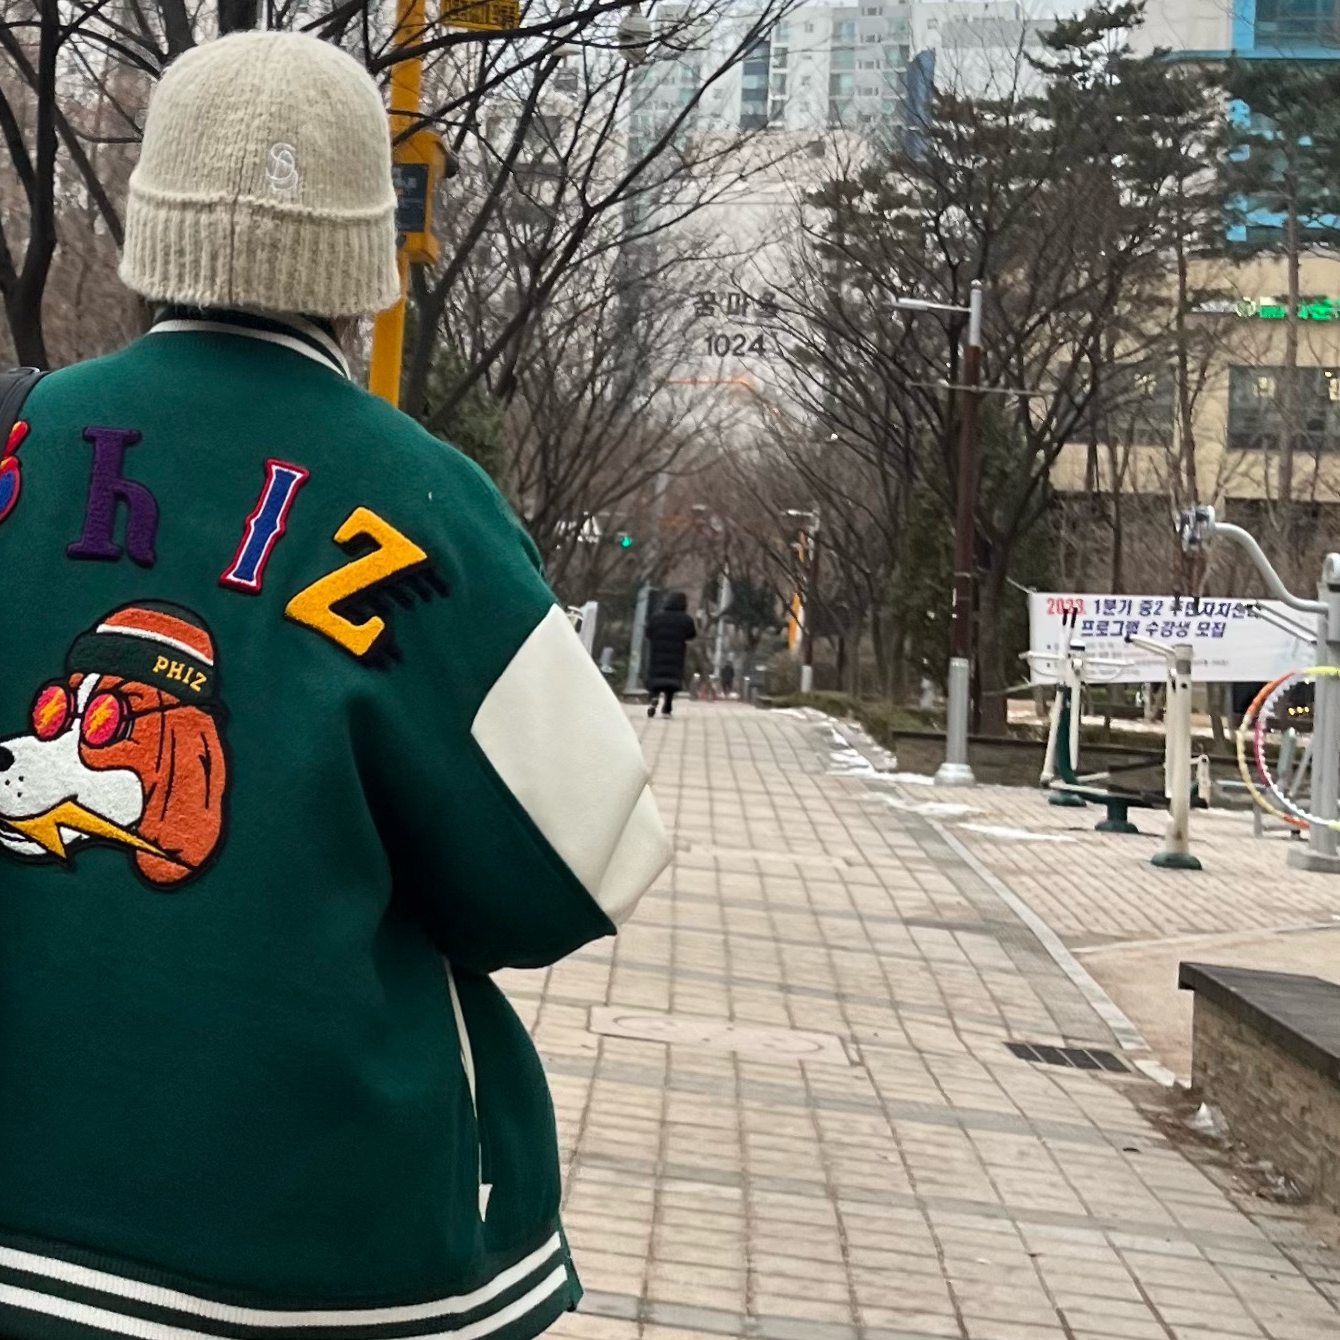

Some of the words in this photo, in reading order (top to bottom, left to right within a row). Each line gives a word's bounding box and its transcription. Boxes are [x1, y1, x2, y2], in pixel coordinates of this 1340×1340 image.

[704, 333, 766, 357] 1024
[1095, 599, 1132, 616] 1분기
[1139, 599, 1163, 616] 중2
[1170, 600, 1259, 619] 주민자치센
[1081, 620, 1140, 637] 프로그램
[1145, 620, 1191, 638] 수강생
[1195, 621, 1227, 638] 모집
[152, 655, 207, 692] PHIZ
